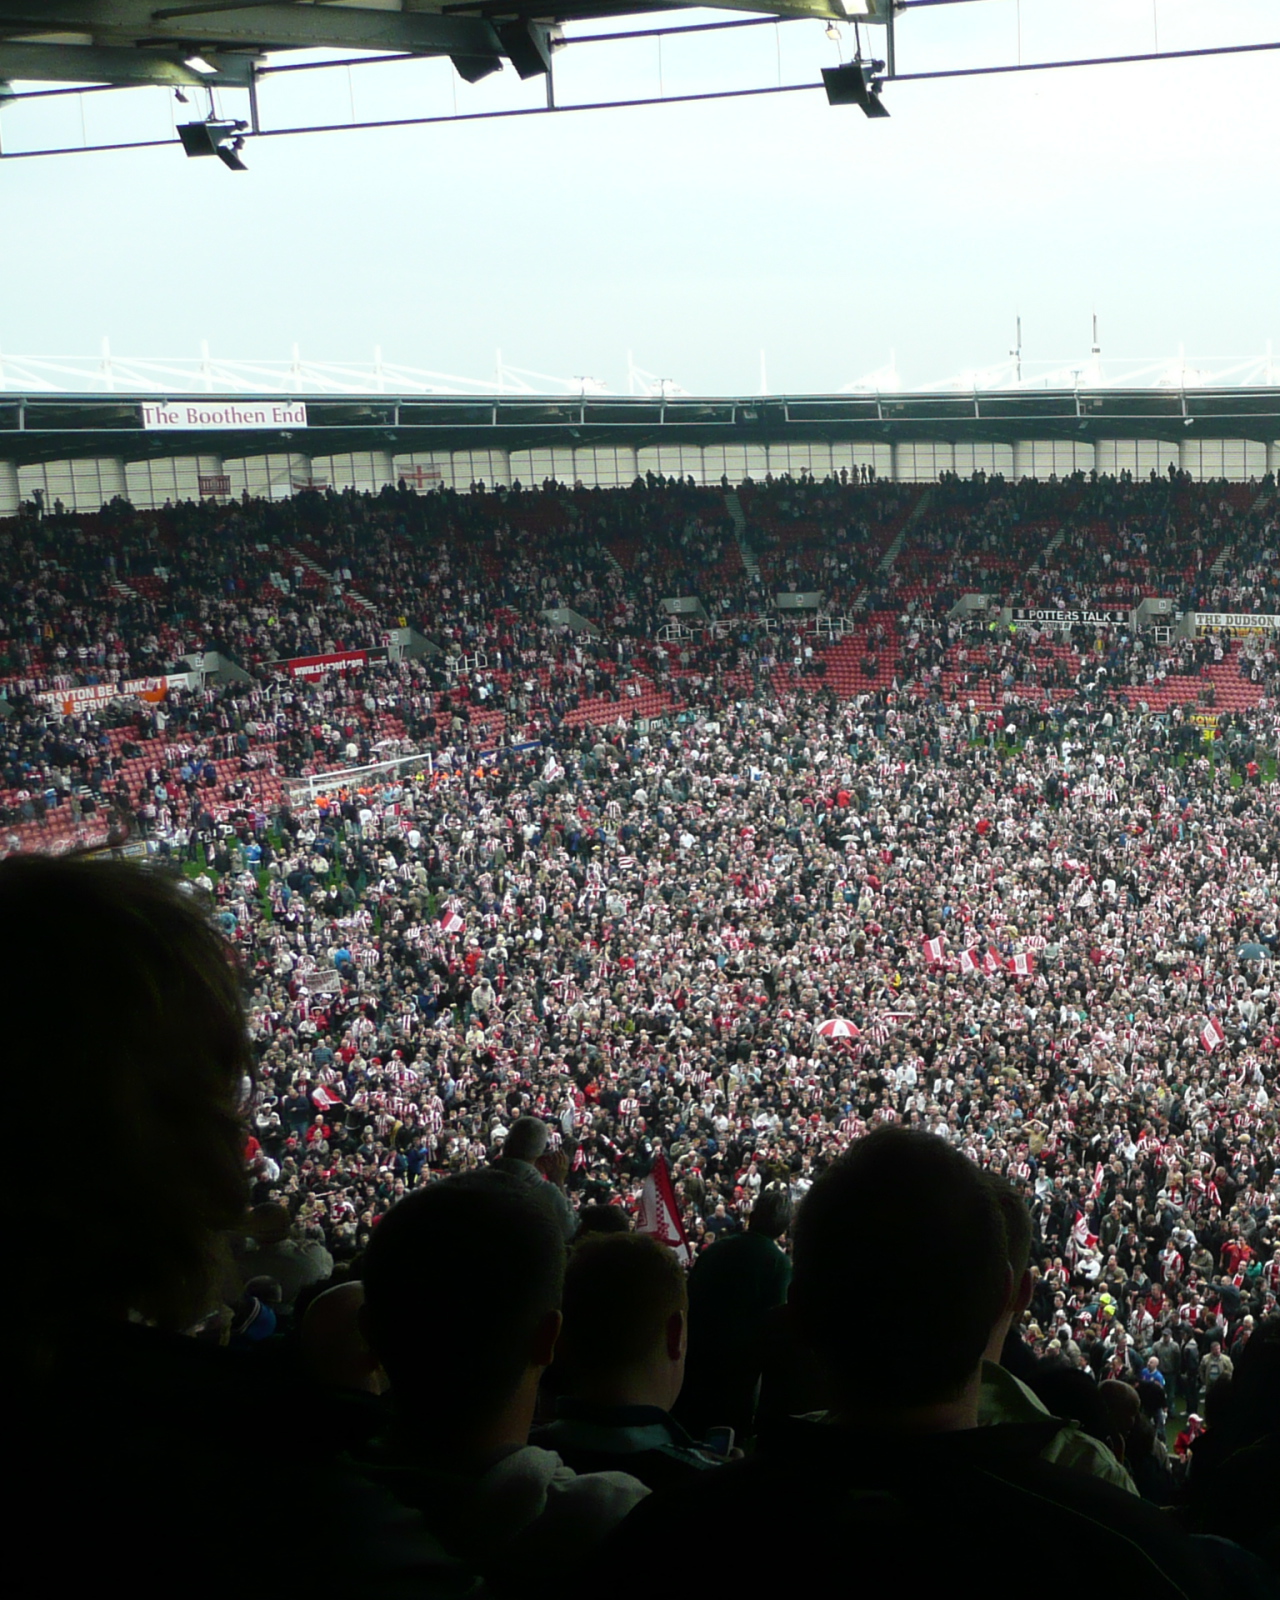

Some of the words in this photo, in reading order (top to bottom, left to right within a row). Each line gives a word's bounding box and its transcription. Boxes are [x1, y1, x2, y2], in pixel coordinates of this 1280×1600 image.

[143, 407, 179, 424] The
[186, 406, 266, 424] Boothen
[272, 406, 305, 422] End
[1029, 610, 1079, 620] POTTERS
[1081, 611, 1111, 621] TALK
[1197, 614, 1222, 625] THE
[1226, 615, 1275, 627] DUDSON
[98, 678, 162, 698] BEAUMOT
